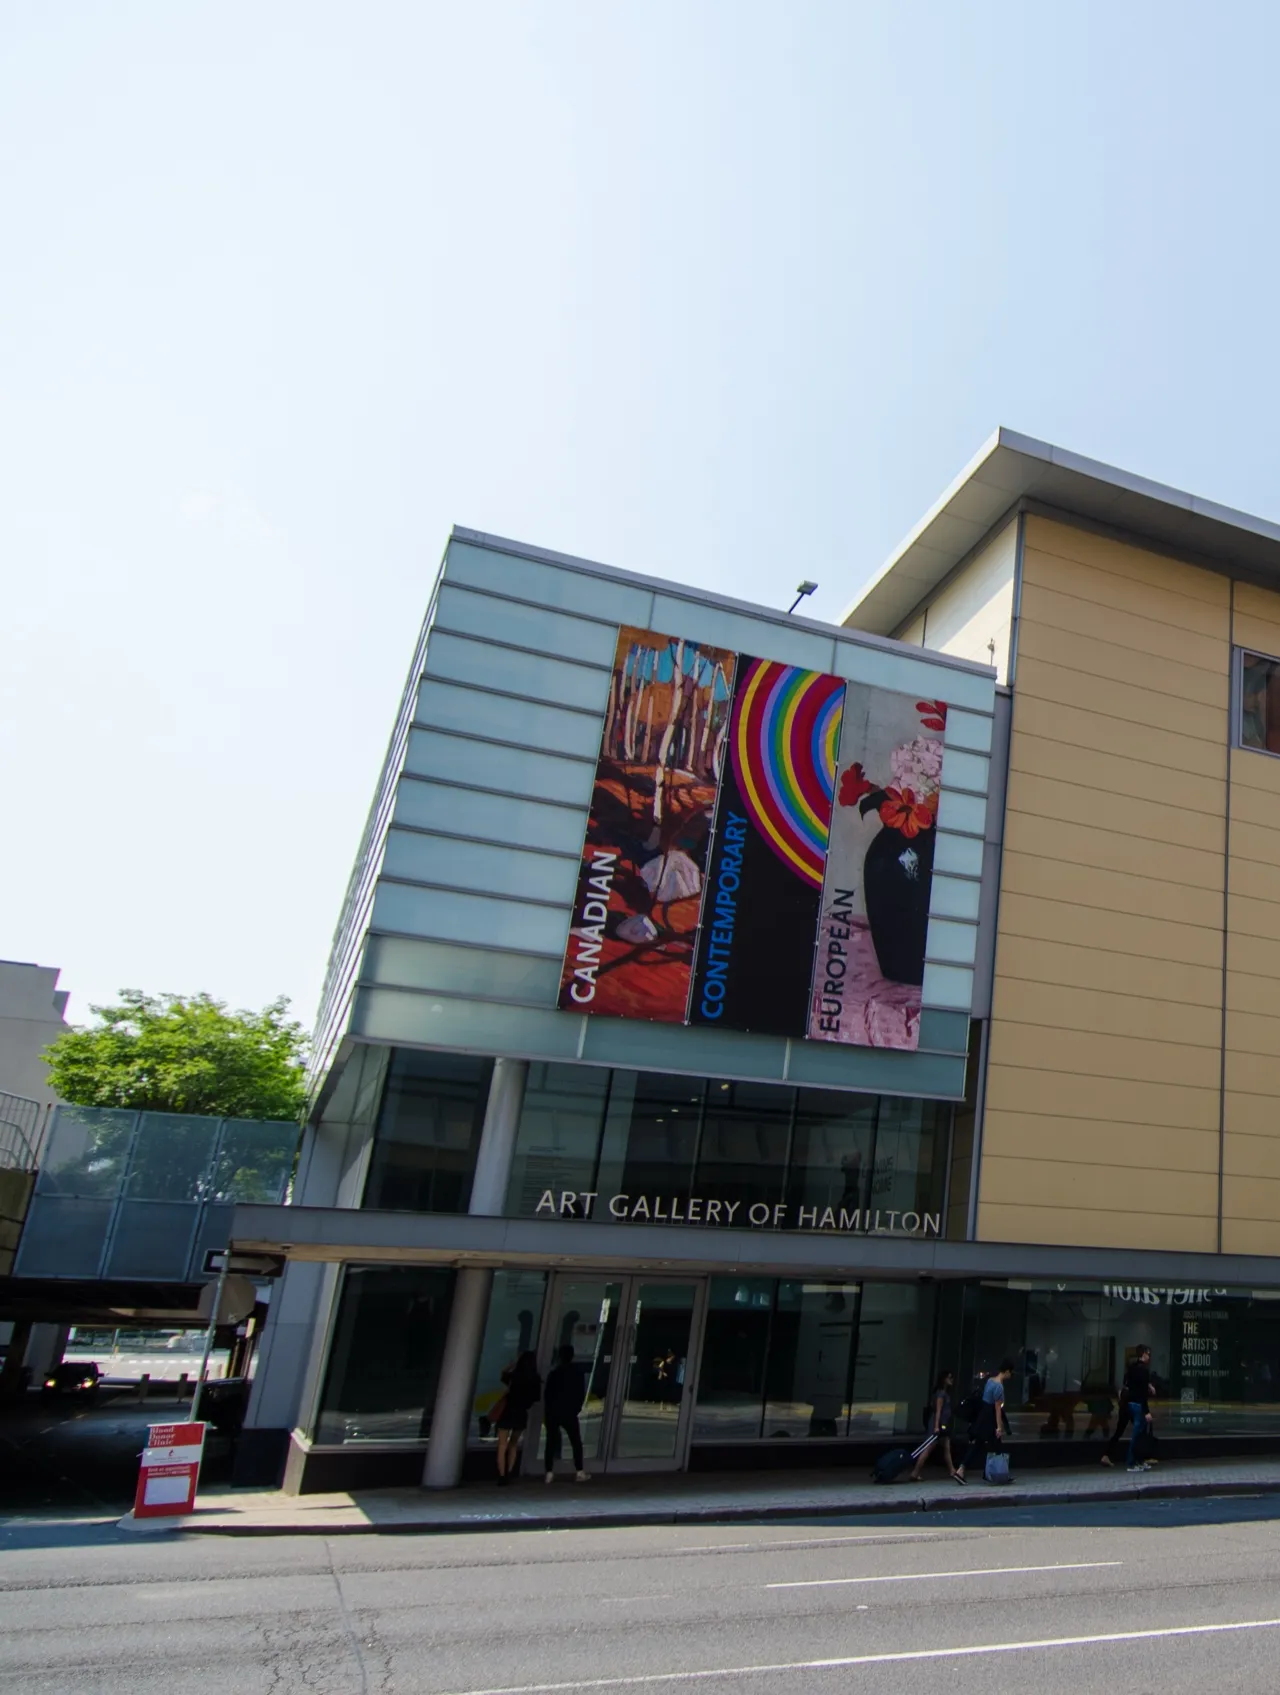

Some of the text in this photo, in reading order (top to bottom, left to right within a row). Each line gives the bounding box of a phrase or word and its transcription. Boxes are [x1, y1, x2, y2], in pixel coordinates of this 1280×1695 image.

[700, 811, 748, 1019] CONTEMPORARY
[569, 851, 617, 1004] CANADIAN
[820, 888, 855, 1033] EUROPEAN
[535, 1189, 941, 1234] ART GALLERY OF HAMILTON
[1182, 1321, 1199, 1335] THE
[1182, 1338, 1218, 1351] ARTIST'S
[1181, 1353, 1211, 1367] STUDIO
[150, 1426, 174, 1434] Blood
[148, 1438, 174, 1446] Clinic
